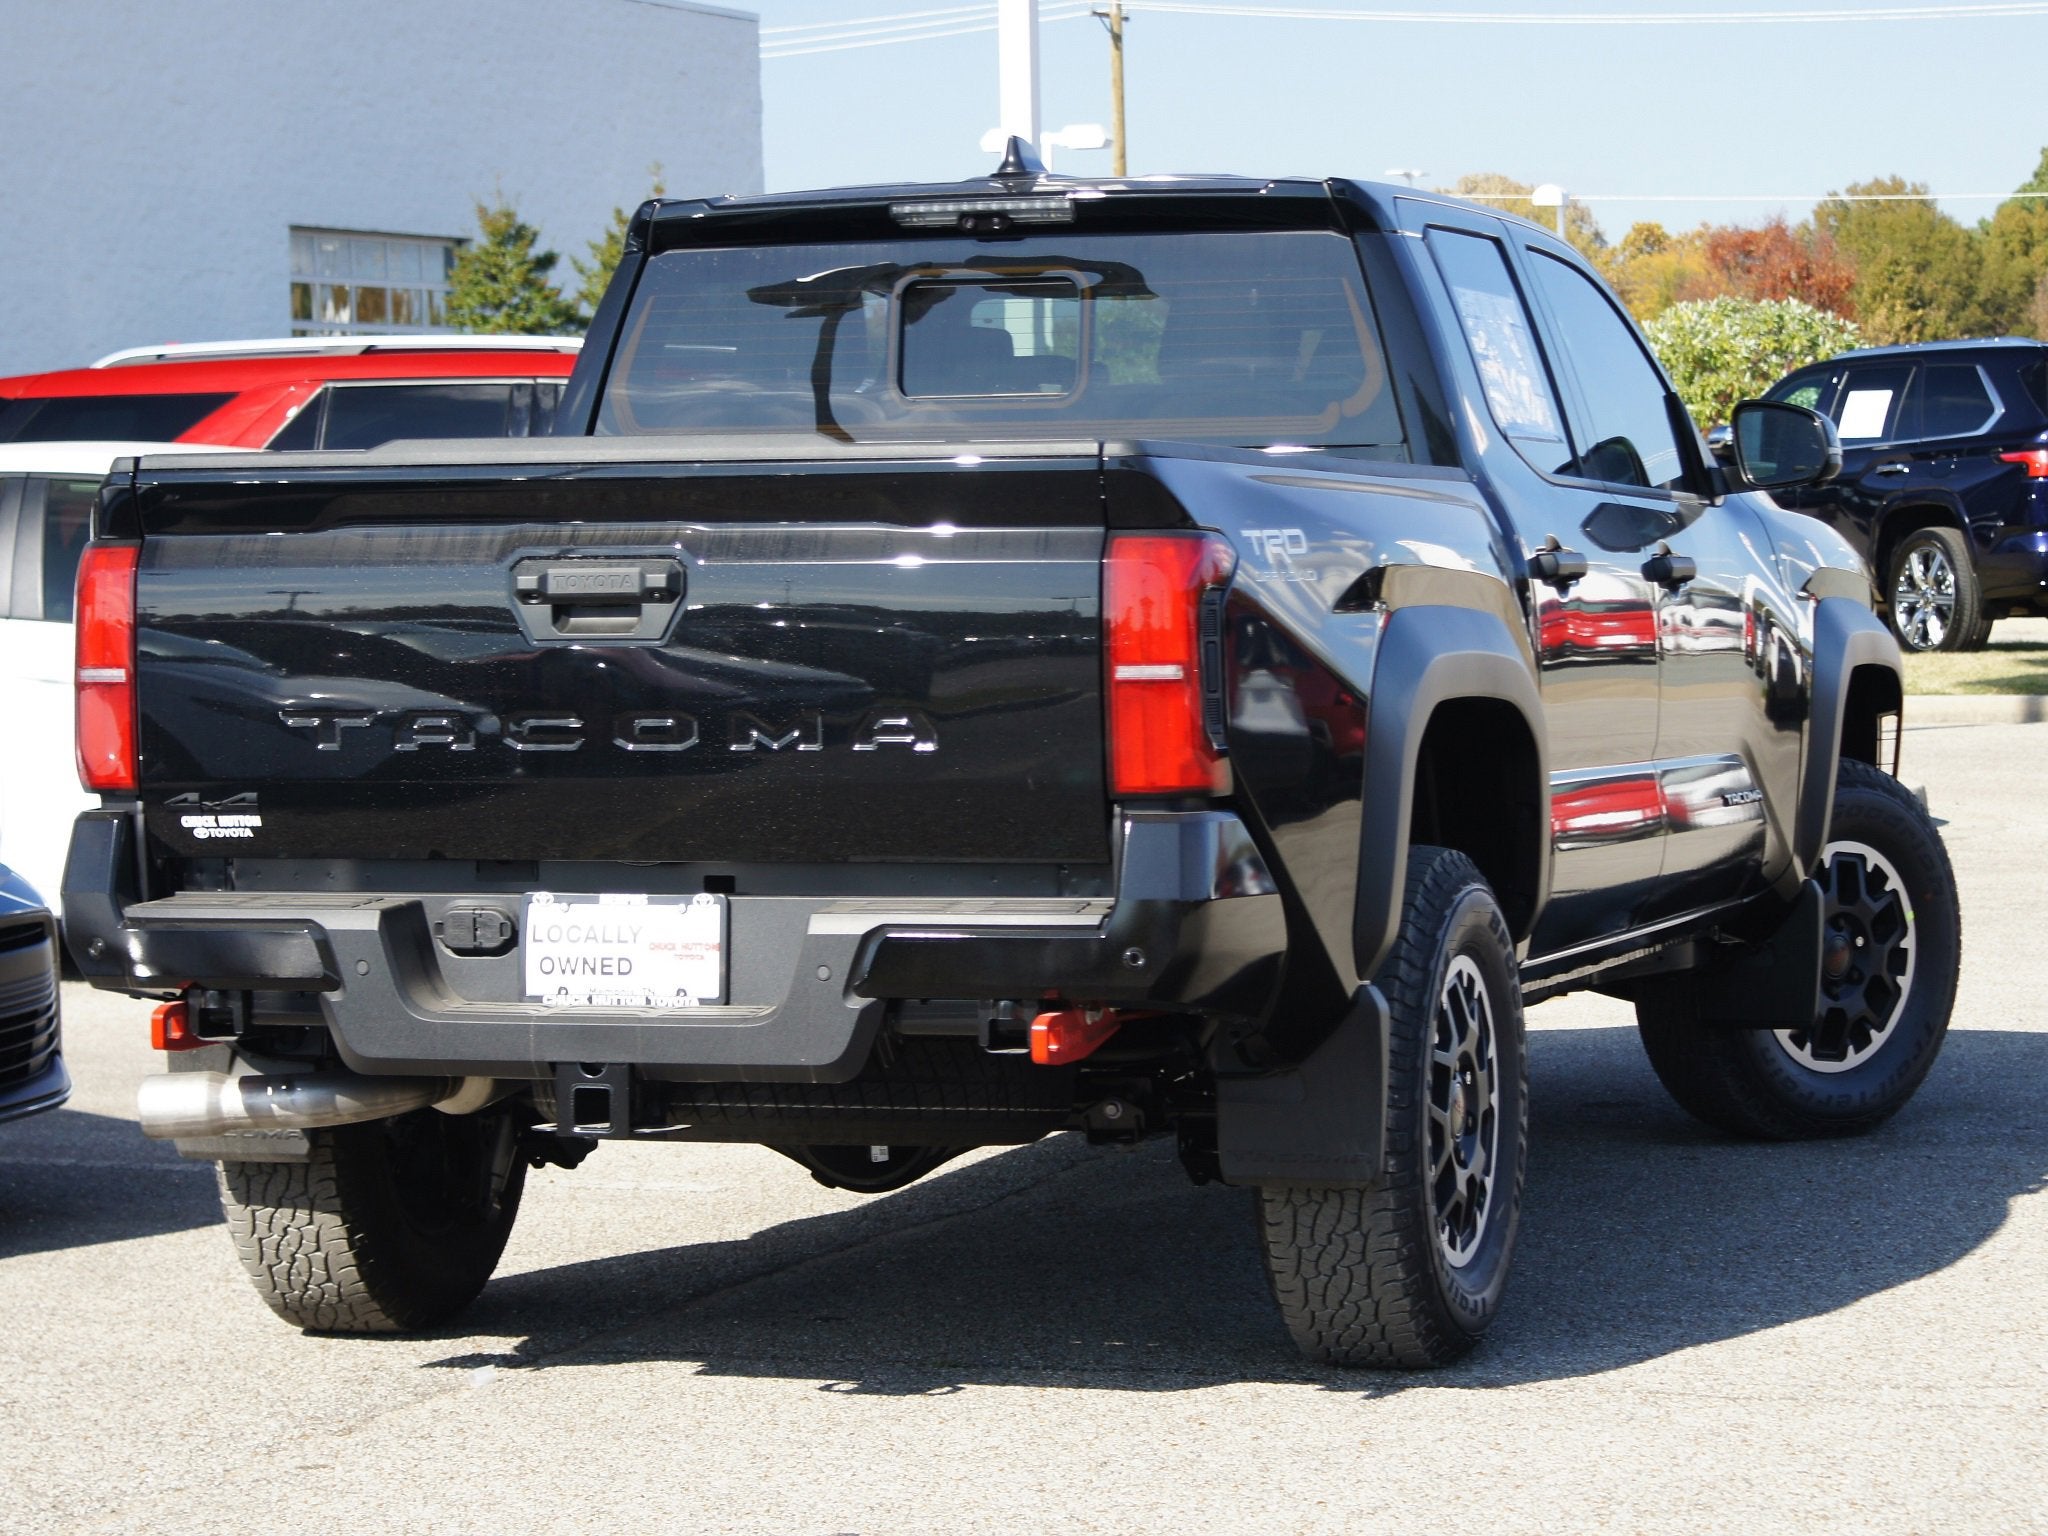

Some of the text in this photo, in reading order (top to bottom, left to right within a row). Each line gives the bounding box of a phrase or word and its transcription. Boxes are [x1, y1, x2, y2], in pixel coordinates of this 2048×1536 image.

[1240, 529, 1308, 563] TRD
[552, 574, 635, 590] TOYOTA
[278, 707, 938, 751] TACOMA
[207, 828, 254, 838] TOYOTA
[532, 925, 644, 944] LOCALLY
[539, 956, 633, 976] OWNED
